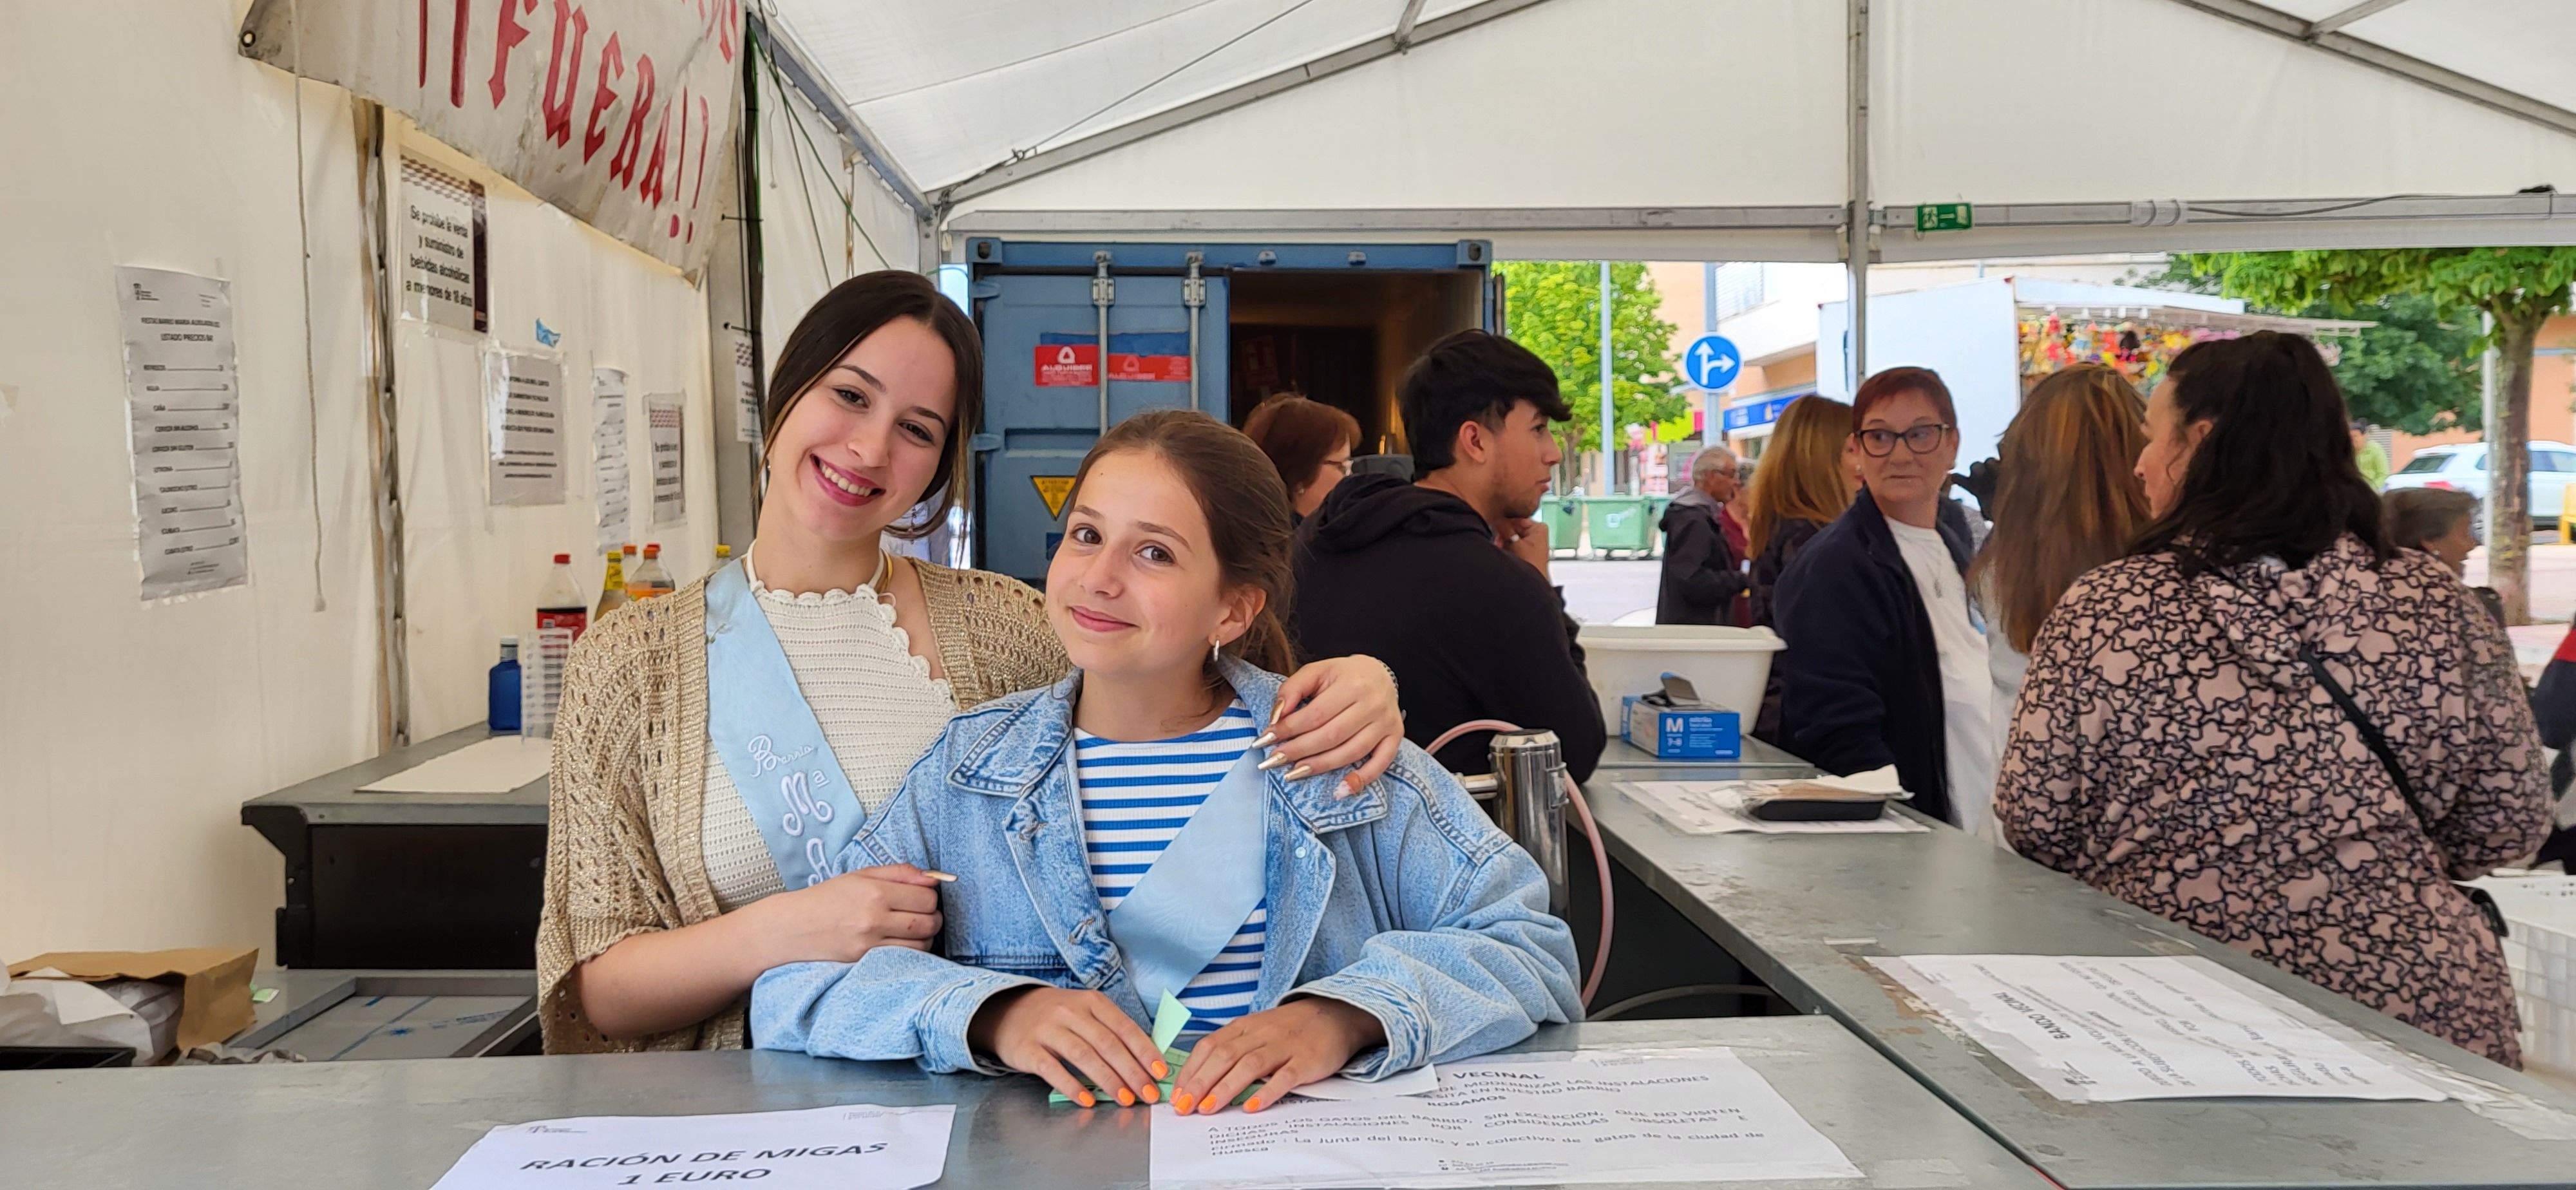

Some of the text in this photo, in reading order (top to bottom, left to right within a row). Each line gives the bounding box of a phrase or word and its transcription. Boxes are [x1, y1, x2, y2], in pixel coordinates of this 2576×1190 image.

[411, 205, 420, 221] Se
[419, 234, 422, 249] y
[410, 253, 438, 274] bebidas
[406, 280, 412, 291] a
[414, 282, 443, 299] menores
[444, 288, 451, 301] de
[1666, 717, 1684, 733] M
[747, 734, 815, 777] Barrio
[2028, 1014, 2071, 1039] BANDO
[1453, 1071, 1546, 1079] VECINAL
[1464, 1081, 1560, 1089] MODERNIZAR
[1598, 1075, 1709, 1086] INSTALACIONES
[1494, 1087, 1562, 1095] NUESTRO
[1427, 1095, 1506, 1107] ROGAMOS
[1209, 1129, 1267, 1139] DICHAS
[1483, 1118, 1609, 1128] CONSIDERARLAS
[1629, 1116, 1718, 1124] OBSOLETAS
[1227, 1122, 1279, 1132] TODOS
[1412, 1114, 1473, 1124] BARRIO,
[1515, 1111, 1604, 1120] EXCEPCIÓN,
[1210, 1129, 1299, 1145] INSEGURAS
[1211, 1138, 1276, 1151] Firmado
[1398, 1135, 1444, 1144] Barrio
[1486, 1135, 1556, 1145] colectivo
[1594, 1133, 1636, 1143] gatos
[1687, 1131, 1739, 1140] ciudad
[520, 1142, 889, 1170] RACIÓN DE MIGAS
[1211, 1146, 1269, 1156] Huesca
[618, 1169, 772, 1185] 1 EURO
